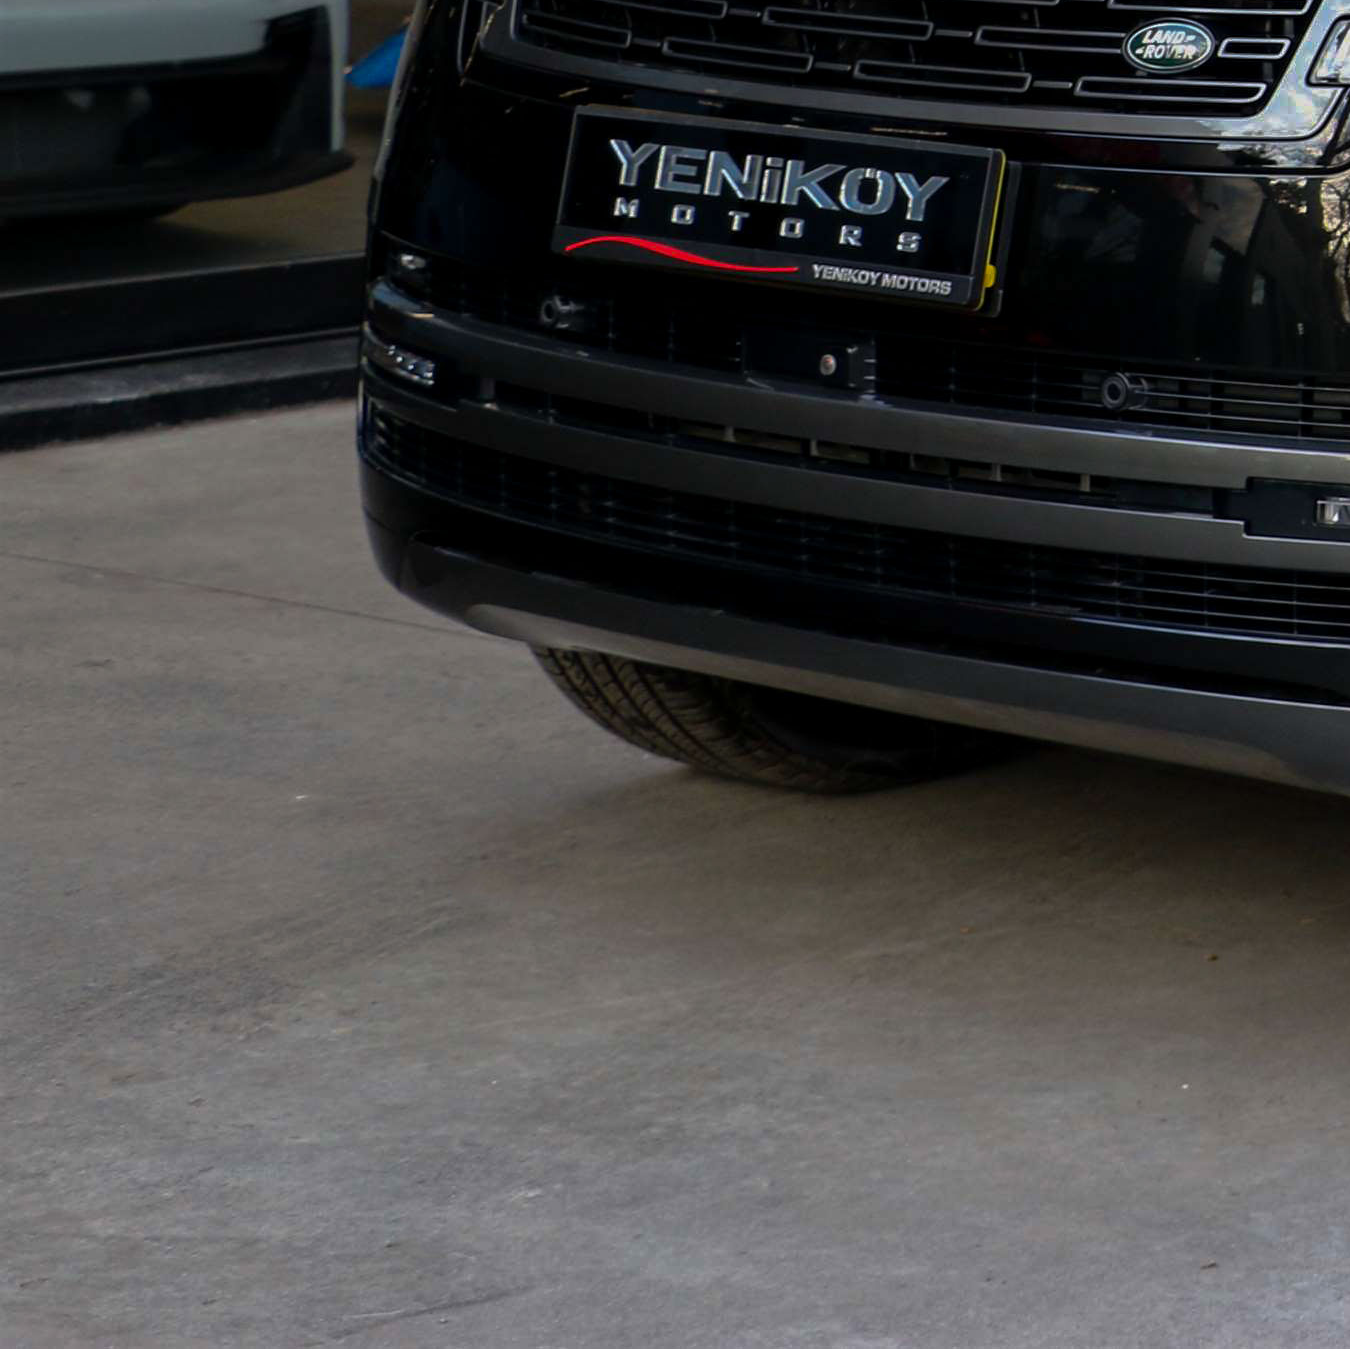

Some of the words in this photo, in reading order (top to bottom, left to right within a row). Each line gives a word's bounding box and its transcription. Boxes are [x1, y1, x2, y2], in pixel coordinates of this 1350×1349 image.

[1142, 30, 1187, 44] LAND
[1142, 45, 1197, 60] ROVER
[613, 196, 922, 253] MOTORS
[880, 272, 953, 296] MOTORS
